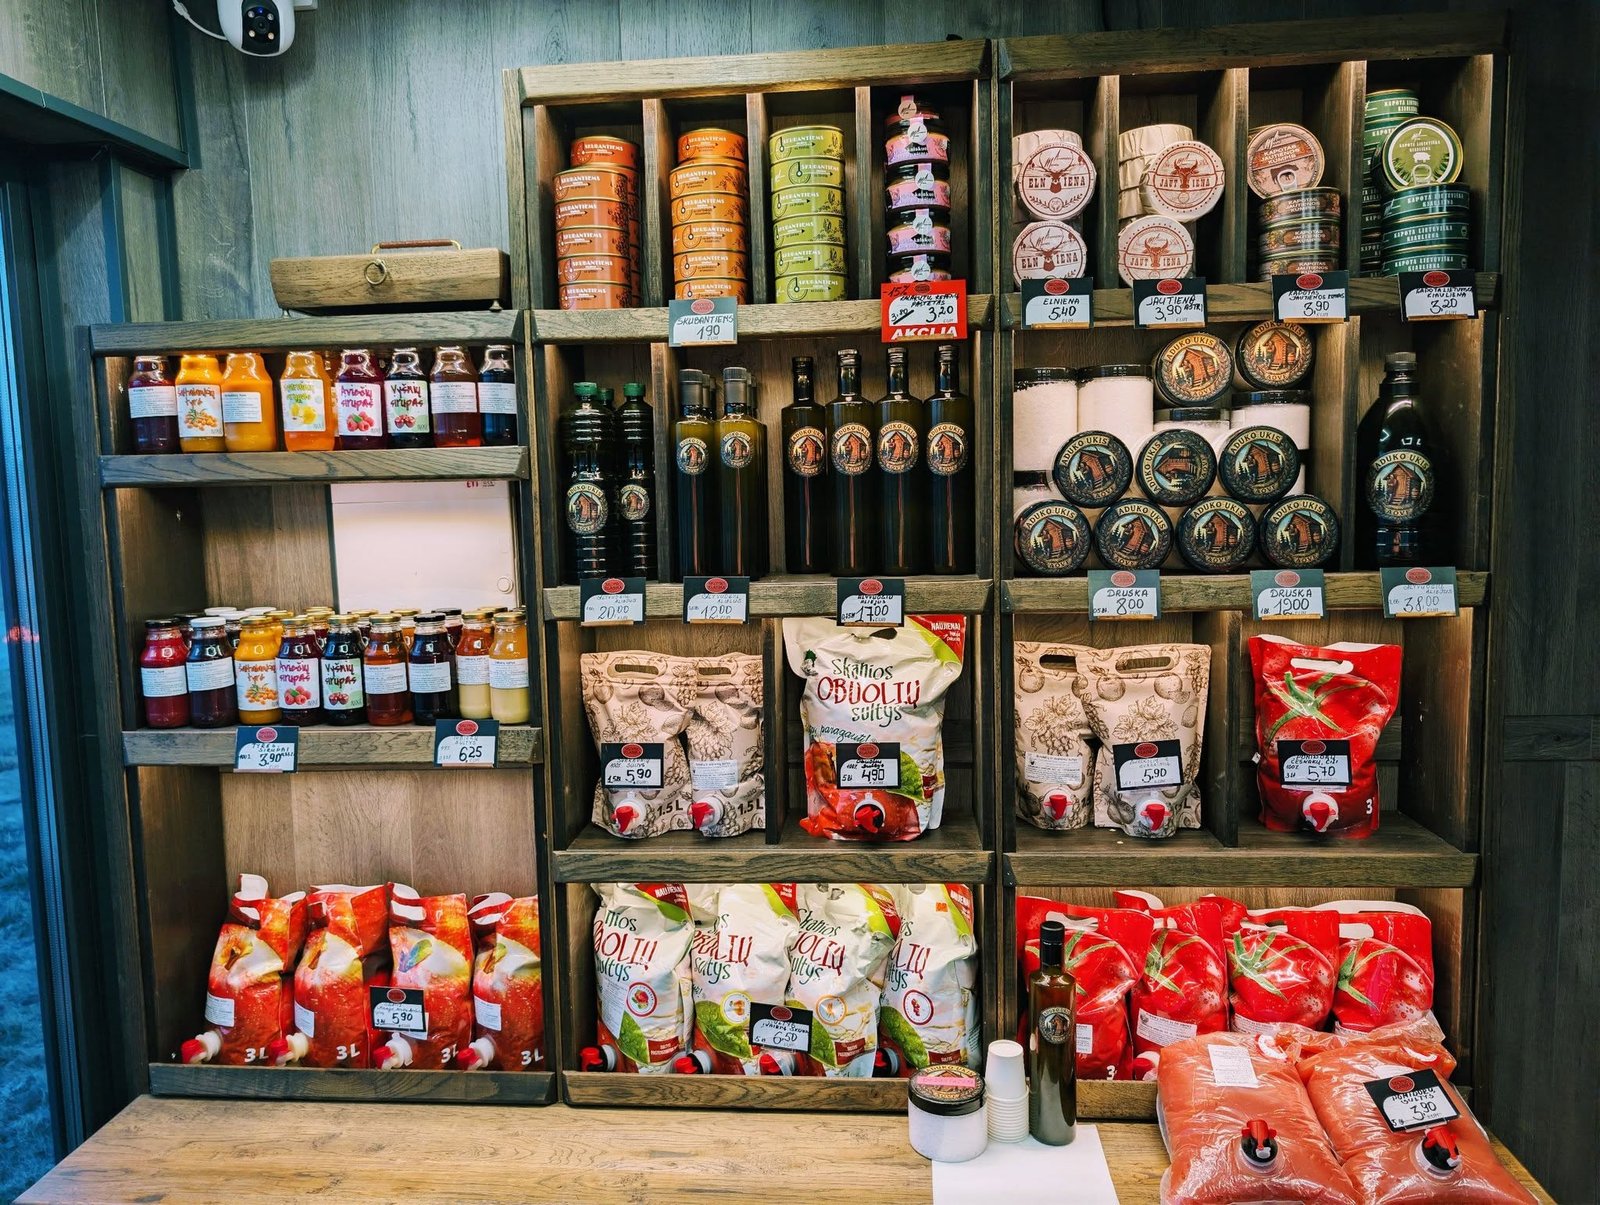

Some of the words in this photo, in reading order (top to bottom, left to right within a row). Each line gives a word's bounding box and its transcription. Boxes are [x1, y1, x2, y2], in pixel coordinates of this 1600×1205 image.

[1043, 297, 1080, 305] ELNIENA
[1146, 294, 1196, 306] JAUTIENA
[677, 314, 733, 326] SKUBANTIEMS
[1166, 338, 1191, 359] ADUKO
[1194, 337, 1215, 347] UKIS
[1061, 439, 1085, 464] ADUKO
[1086, 436, 1108, 445] UKIS
[1145, 441, 1161, 462] UKIS
[1230, 432, 1257, 454] ADUKO
[1260, 431, 1281, 442] UKIS
[1374, 453, 1406, 469] ADUKO
[1409, 454, 1429, 470] UKIS
[1144, 464, 1161, 492] ADUKO
[1026, 508, 1052, 529] ADUKO
[1054, 507, 1076, 519] UKIS
[1118, 505, 1148, 515] ADUKO
[1150, 512, 1166, 529] UKIS
[1193, 501, 1222, 517] ADUKO
[1224, 501, 1244, 518] UKIS
[1272, 501, 1300, 522] ADUKO
[1302, 501, 1324, 514] UKIS
[1107, 589, 1148, 598] DRUSKA
[1270, 588, 1312, 598] DRUSKA
[832, 657, 894, 681] Skanios
[816, 675, 921, 709] OBUOLIŲ
[851, 703, 903, 728] sultys
